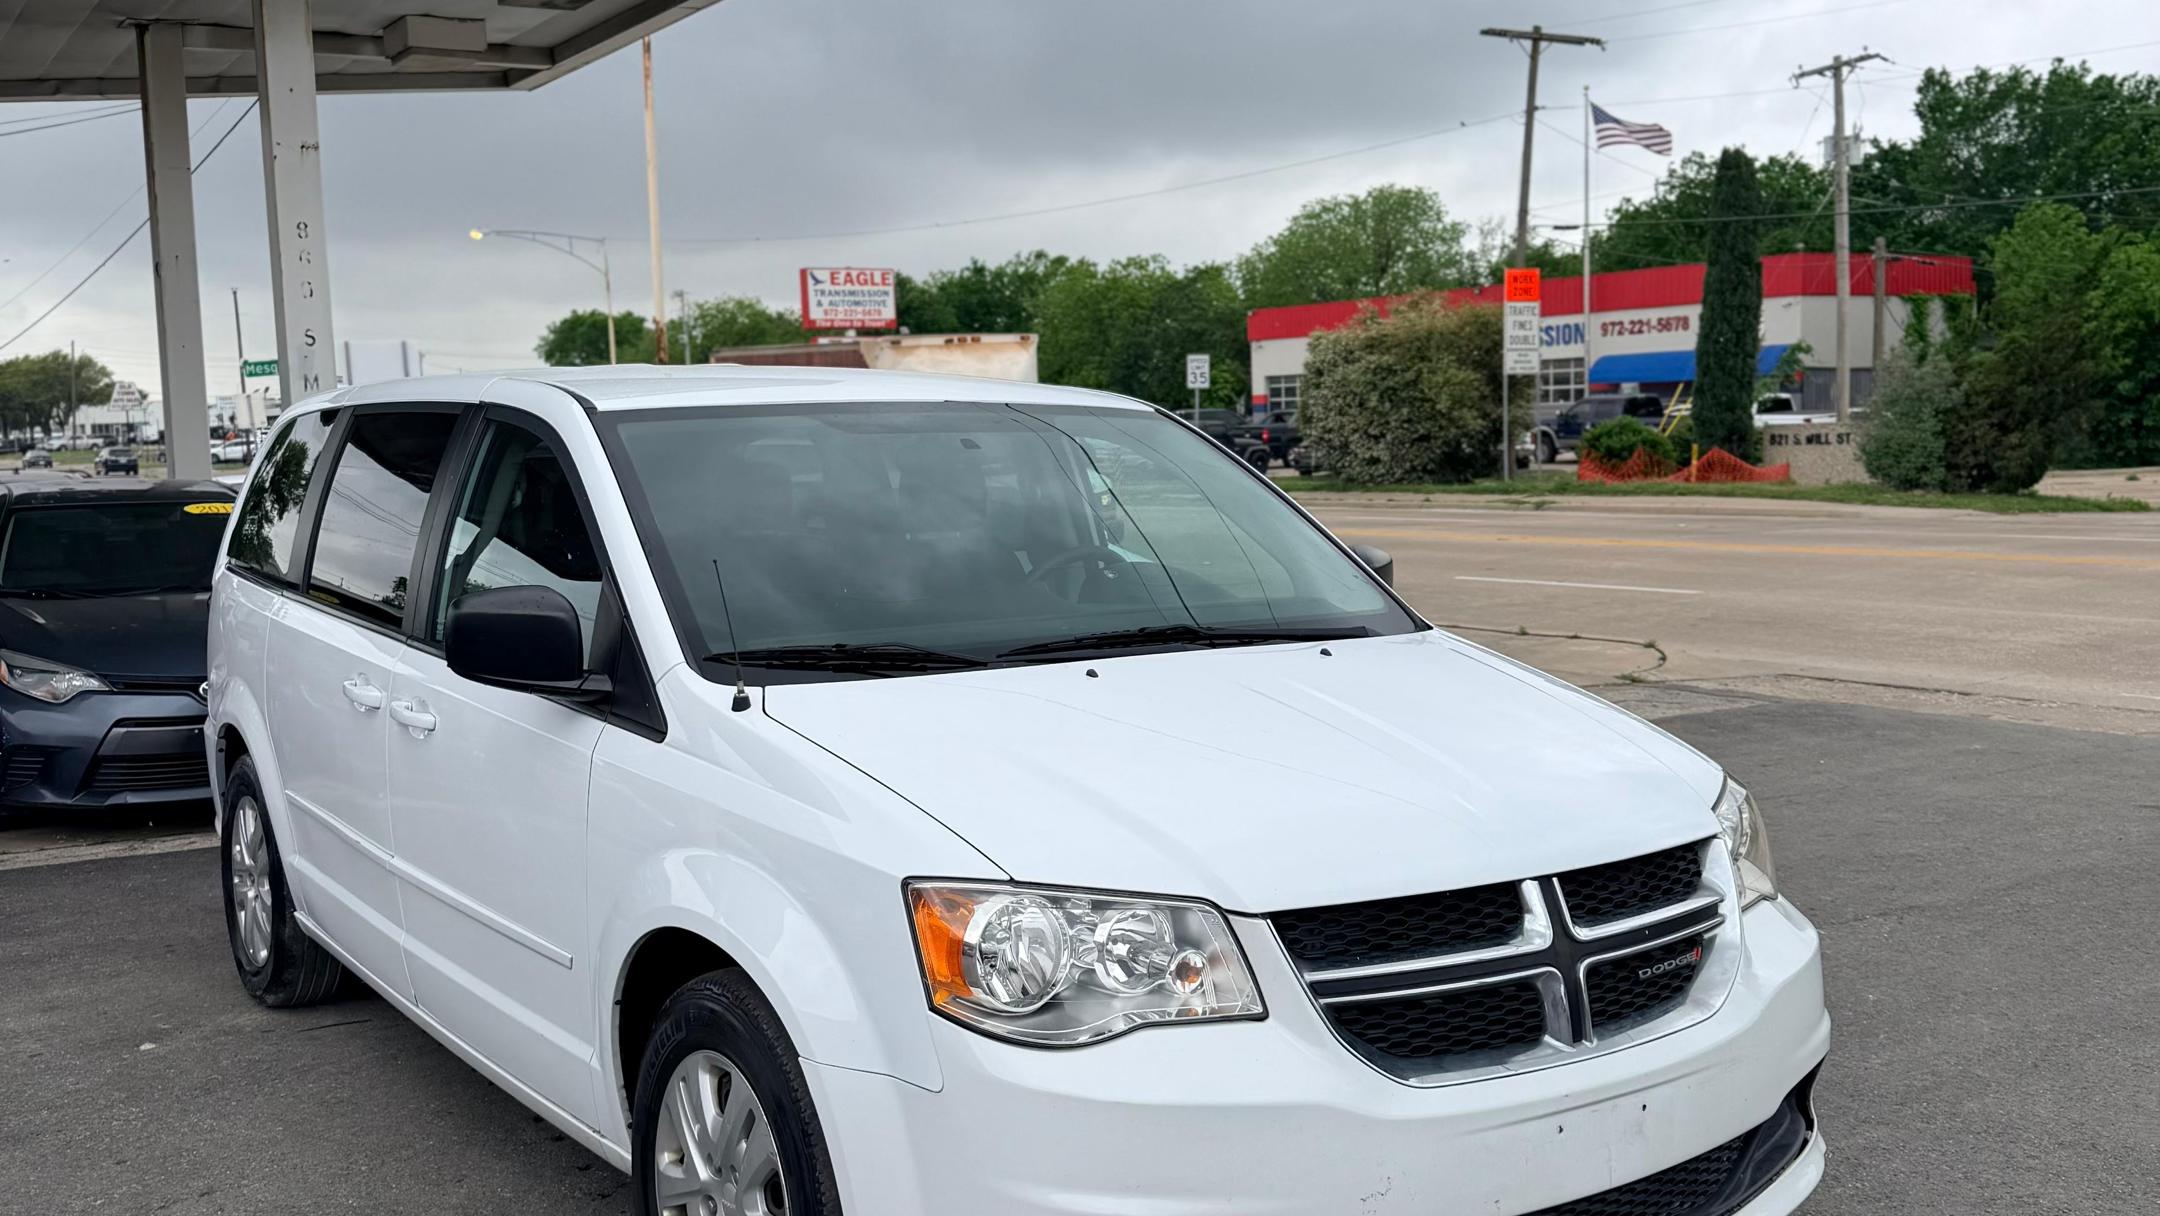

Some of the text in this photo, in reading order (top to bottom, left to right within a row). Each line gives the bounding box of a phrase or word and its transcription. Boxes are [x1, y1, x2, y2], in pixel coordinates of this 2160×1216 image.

[830, 271, 891, 286] EAGLE
[1512, 276, 1533, 284] WORK
[814, 289, 889, 297] TRANSMISSION
[1513, 287, 1533, 296] ZONE
[816, 299, 887, 307] & AUTOMOTIVE
[1509, 305, 1537, 316] TRAFFIC
[1512, 320, 1533, 331] FINES
[1601, 316, 1689, 337] 972-221-5678
[1509, 335, 1536, 346] DOUBLE
[1190, 371, 1208, 384] 35
[1769, 433, 1789, 446] 821
[1805, 433, 1833, 445] MILL
[1836, 432, 1851, 445] ST
[1639, 951, 1696, 978] DODGE
